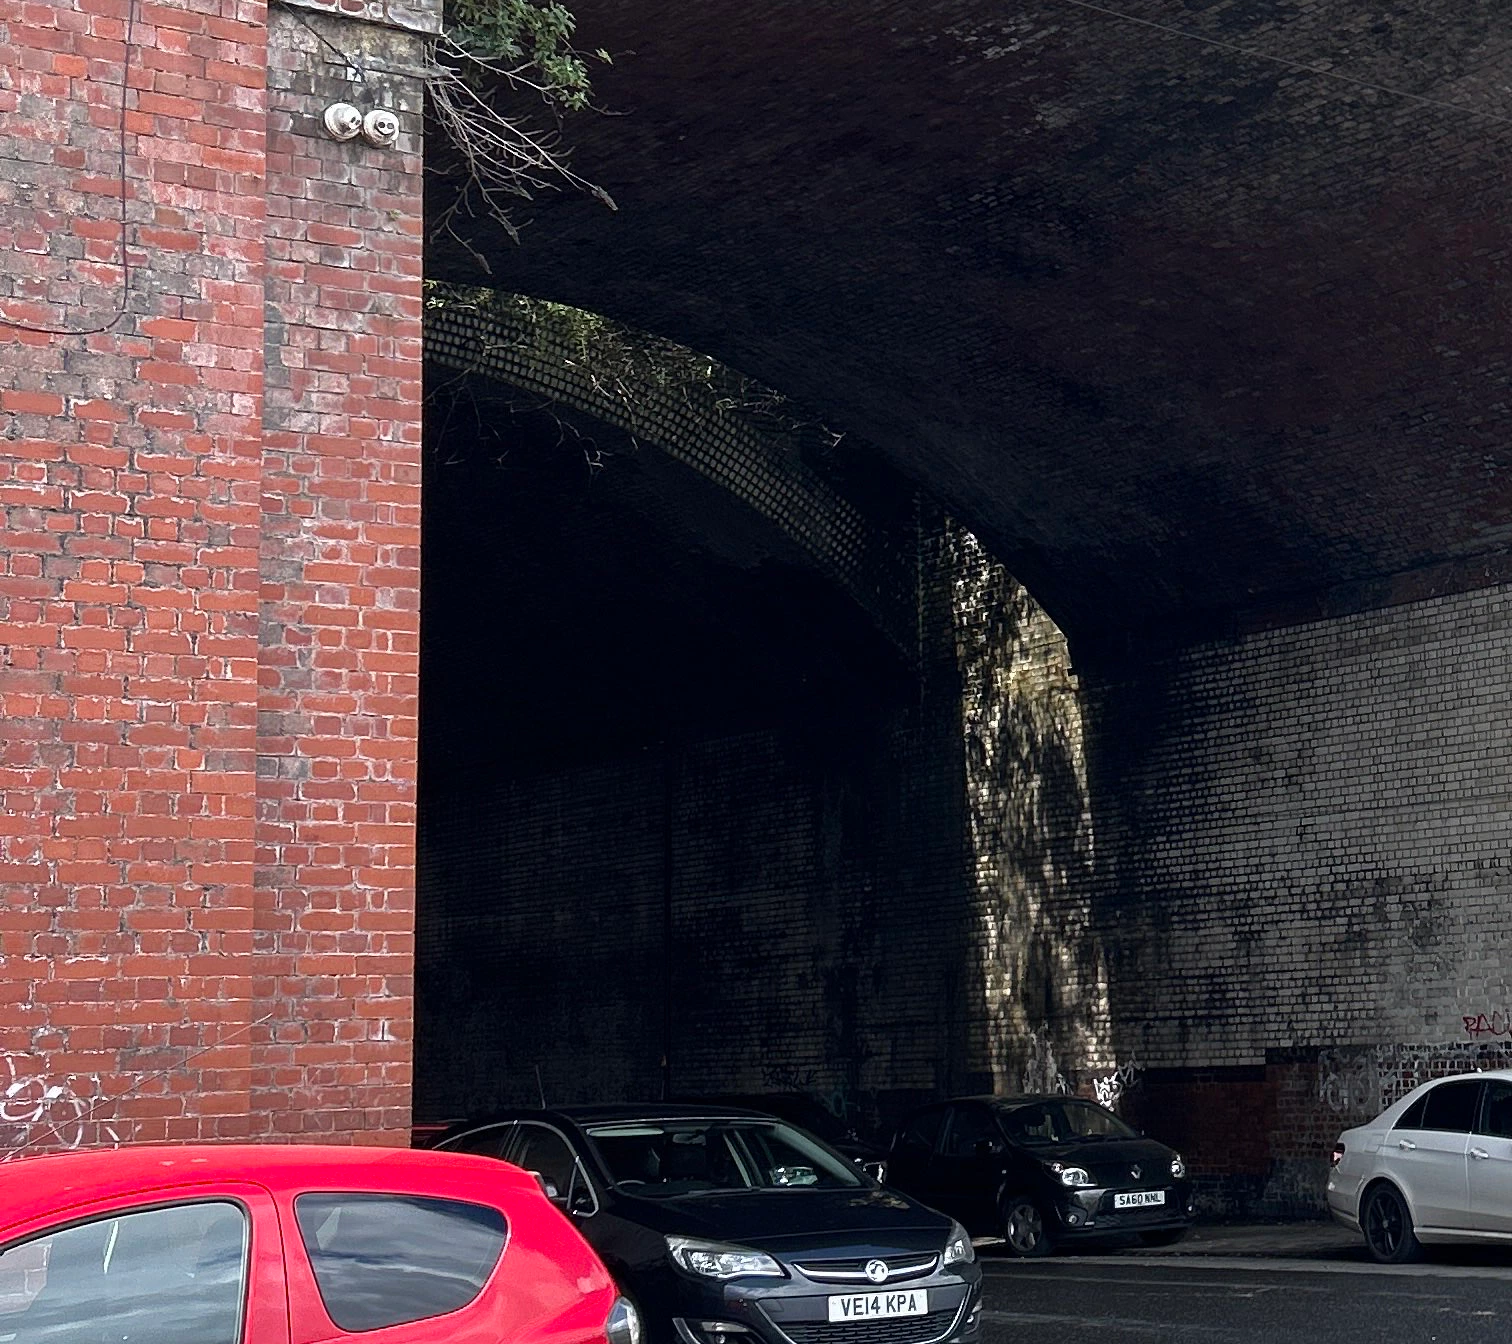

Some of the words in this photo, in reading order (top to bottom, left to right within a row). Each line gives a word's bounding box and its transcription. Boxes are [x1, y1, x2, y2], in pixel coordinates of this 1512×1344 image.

[1119, 1193, 1143, 1206] SA60
[840, 1295, 881, 1317] VE14
[886, 1293, 917, 1314] KPA
